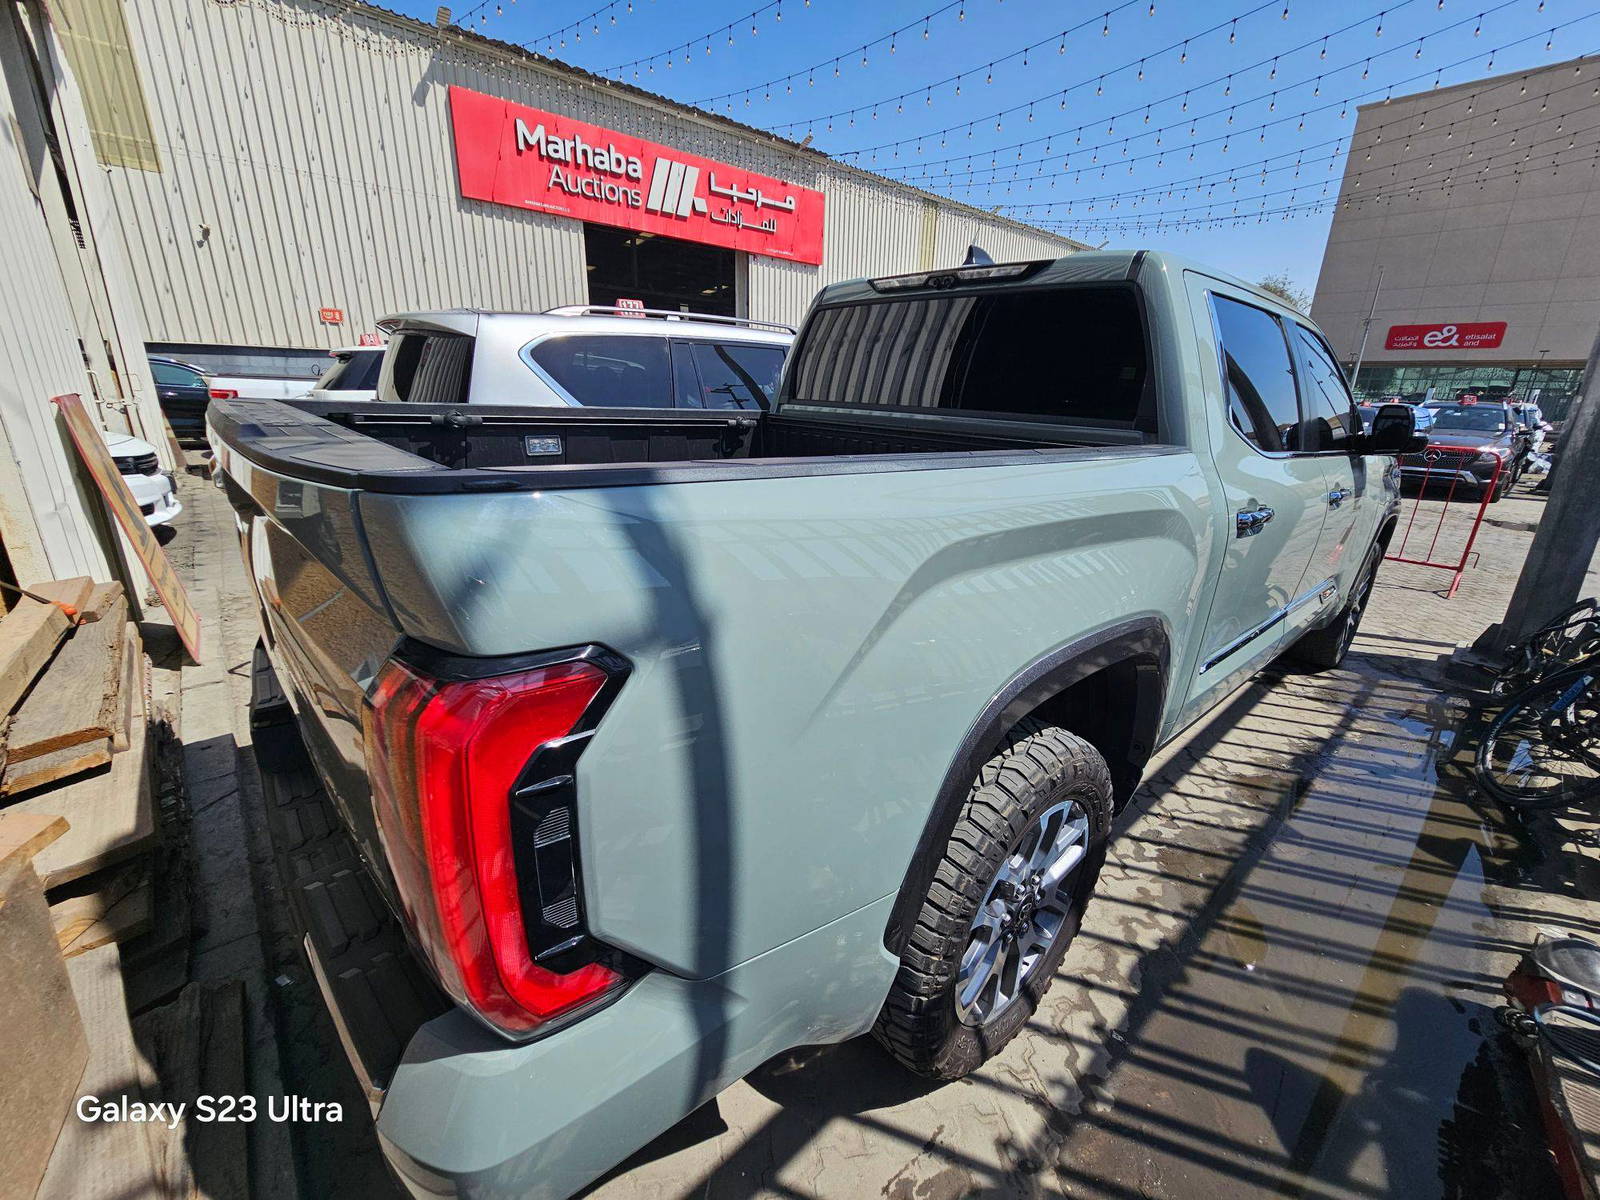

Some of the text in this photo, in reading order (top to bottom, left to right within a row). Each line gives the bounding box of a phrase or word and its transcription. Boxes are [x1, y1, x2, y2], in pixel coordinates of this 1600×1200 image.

[515, 117, 643, 180] Marhaba
[547, 164, 643, 207] Auctions
[710, 171, 796, 209] مرحبا
[711, 207, 777, 233] للمزادات
[1463, 339, 1480, 347] and
